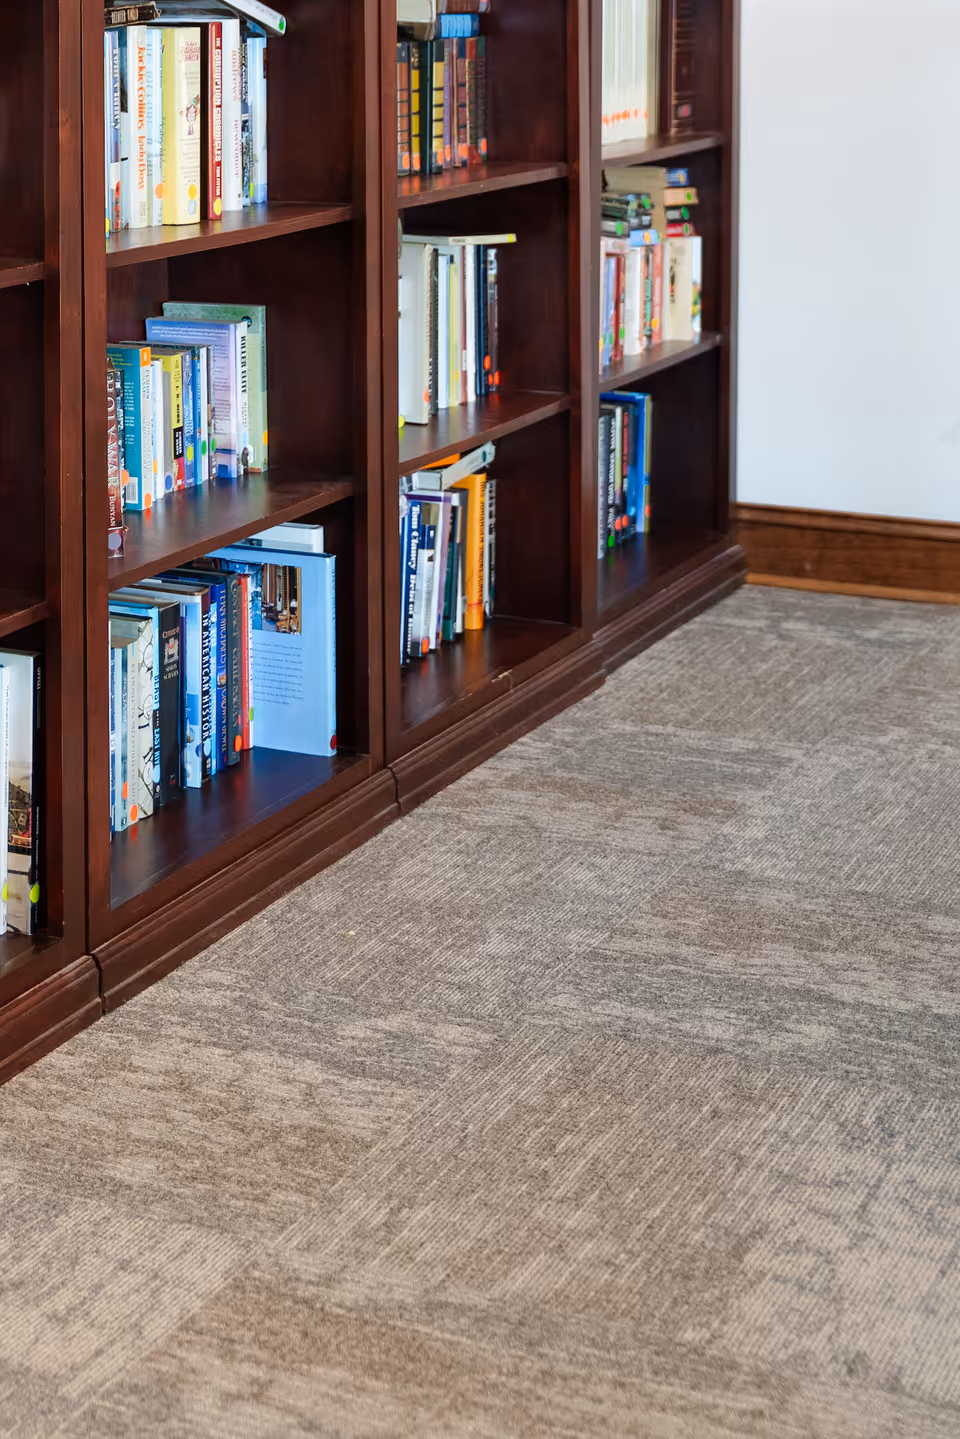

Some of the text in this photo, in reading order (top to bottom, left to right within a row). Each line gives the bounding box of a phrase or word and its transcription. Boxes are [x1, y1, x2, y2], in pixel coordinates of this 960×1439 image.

[214, 48, 222, 106] CORRUPTION
[137, 41, 146, 189] Jackie Collins Lady Boss
[214, 107, 222, 162] CHRONICLES
[410, 504, 420, 530] Tom
[408, 529, 418, 570] Clancy
